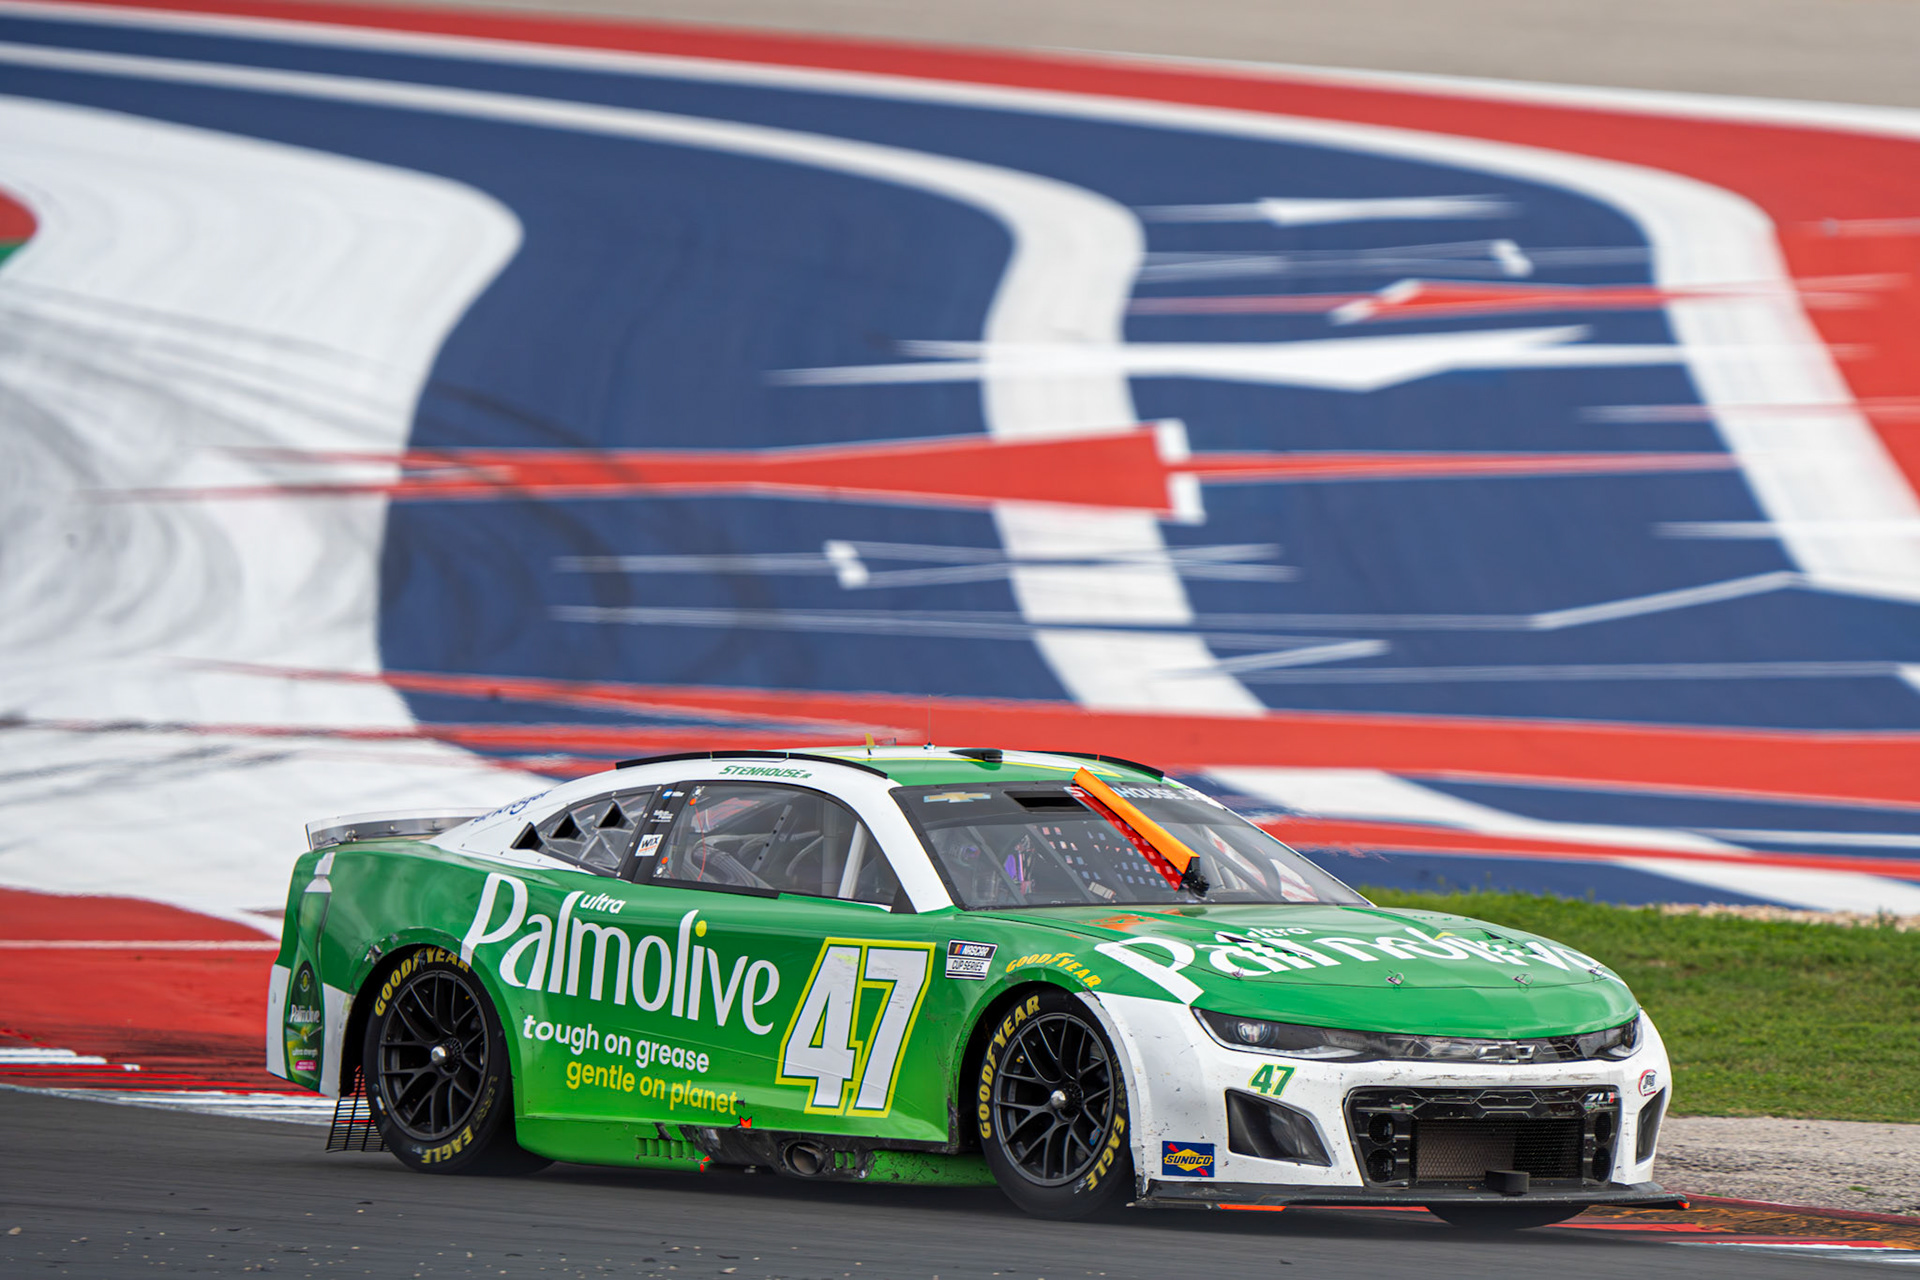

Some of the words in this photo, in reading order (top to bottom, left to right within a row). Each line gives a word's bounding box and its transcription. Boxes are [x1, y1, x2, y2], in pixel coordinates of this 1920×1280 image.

[719, 765, 806, 778] STENHOUSE
[580, 892, 626, 914] ultra
[460, 871, 781, 1035] Palmolive
[952, 959, 965, 970] CUP
[962, 944, 990, 957] NASCAR
[1005, 952, 1102, 988] GOODYEAR
[523, 1014, 600, 1056] tough
[604, 1033, 631, 1057] on
[635, 1039, 710, 1073] grease
[775, 937, 936, 1118] 47
[978, 994, 1041, 1140] GOODYEAR
[1248, 1062, 1297, 1098] 47
[566, 1061, 635, 1092] gentle
[640, 1075, 666, 1100] on
[669, 1079, 738, 1116] planet
[420, 1124, 474, 1164] EAGLE
[1084, 1113, 1126, 1192] EAGLE
[1166, 1154, 1212, 1165] SUNOCO
